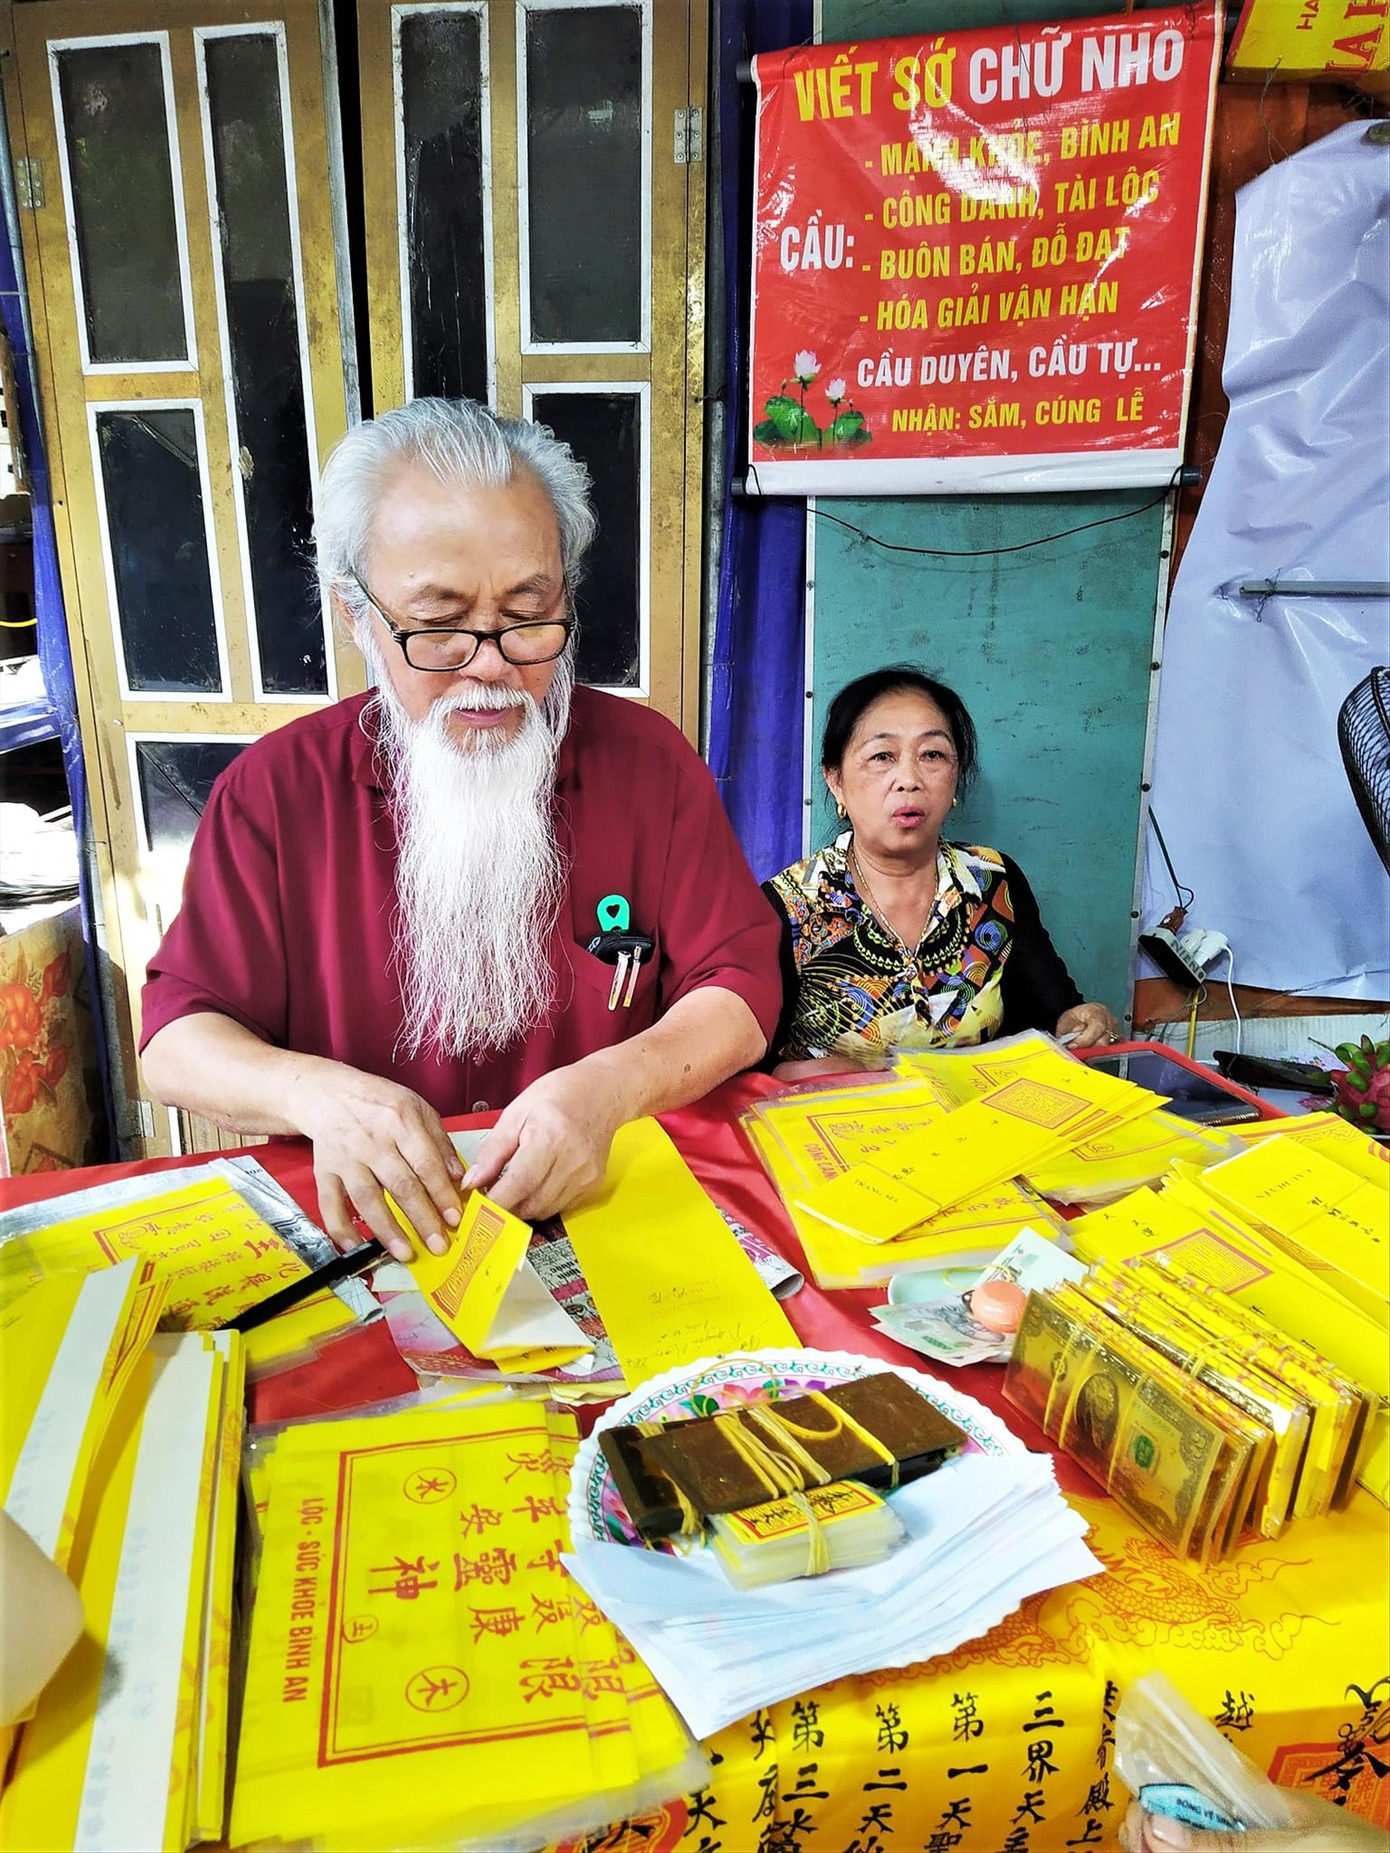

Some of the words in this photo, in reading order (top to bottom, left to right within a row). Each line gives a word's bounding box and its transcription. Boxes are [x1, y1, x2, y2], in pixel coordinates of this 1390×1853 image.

[793, 45, 878, 122] VIẾT
[892, 38, 957, 110] SỚ
[968, 26, 1071, 104] CHỮ
[1080, 29, 1185, 92] NHO
[880, 141, 960, 182] MẠNH
[969, 116, 1050, 171] KHỎE,
[1059, 116, 1130, 160] BÌNH
[1139, 111, 1181, 147] AN
[882, 185, 951, 230] CÔNG
[963, 183, 1043, 222] DANH,
[1055, 177, 1100, 215] TÀI
[1105, 166, 1161, 210] LỘC
[780, 209, 855, 271] CẦU:
[880, 241, 951, 280] BUÔN
[959, 236, 1021, 275] BÁN,
[1031, 223, 1068, 269] ĐỖ
[1076, 227, 1131, 268] ĐẠT
[877, 296, 929, 331] HÓA
[937, 282, 989, 328] GIẢI
[998, 289, 1050, 329] VẬN
[1059, 282, 1119, 325] HẠN
[857, 346, 911, 388] CẦU
[920, 345, 1019, 386] DUYÊN,
[1028, 333, 1088, 377] CẦU
[1095, 338, 1161, 377] TỰ...
[892, 403, 960, 435] NHẬN:
[968, 398, 1026, 431] SẮM,
[1035, 395, 1101, 426] CÚNG
[1116, 387, 1144, 421] LỄ
[299, 1498, 328, 1526] LỘC
[296, 1539, 322, 1573] SỨC
[282, 1674, 308, 1703] AN
